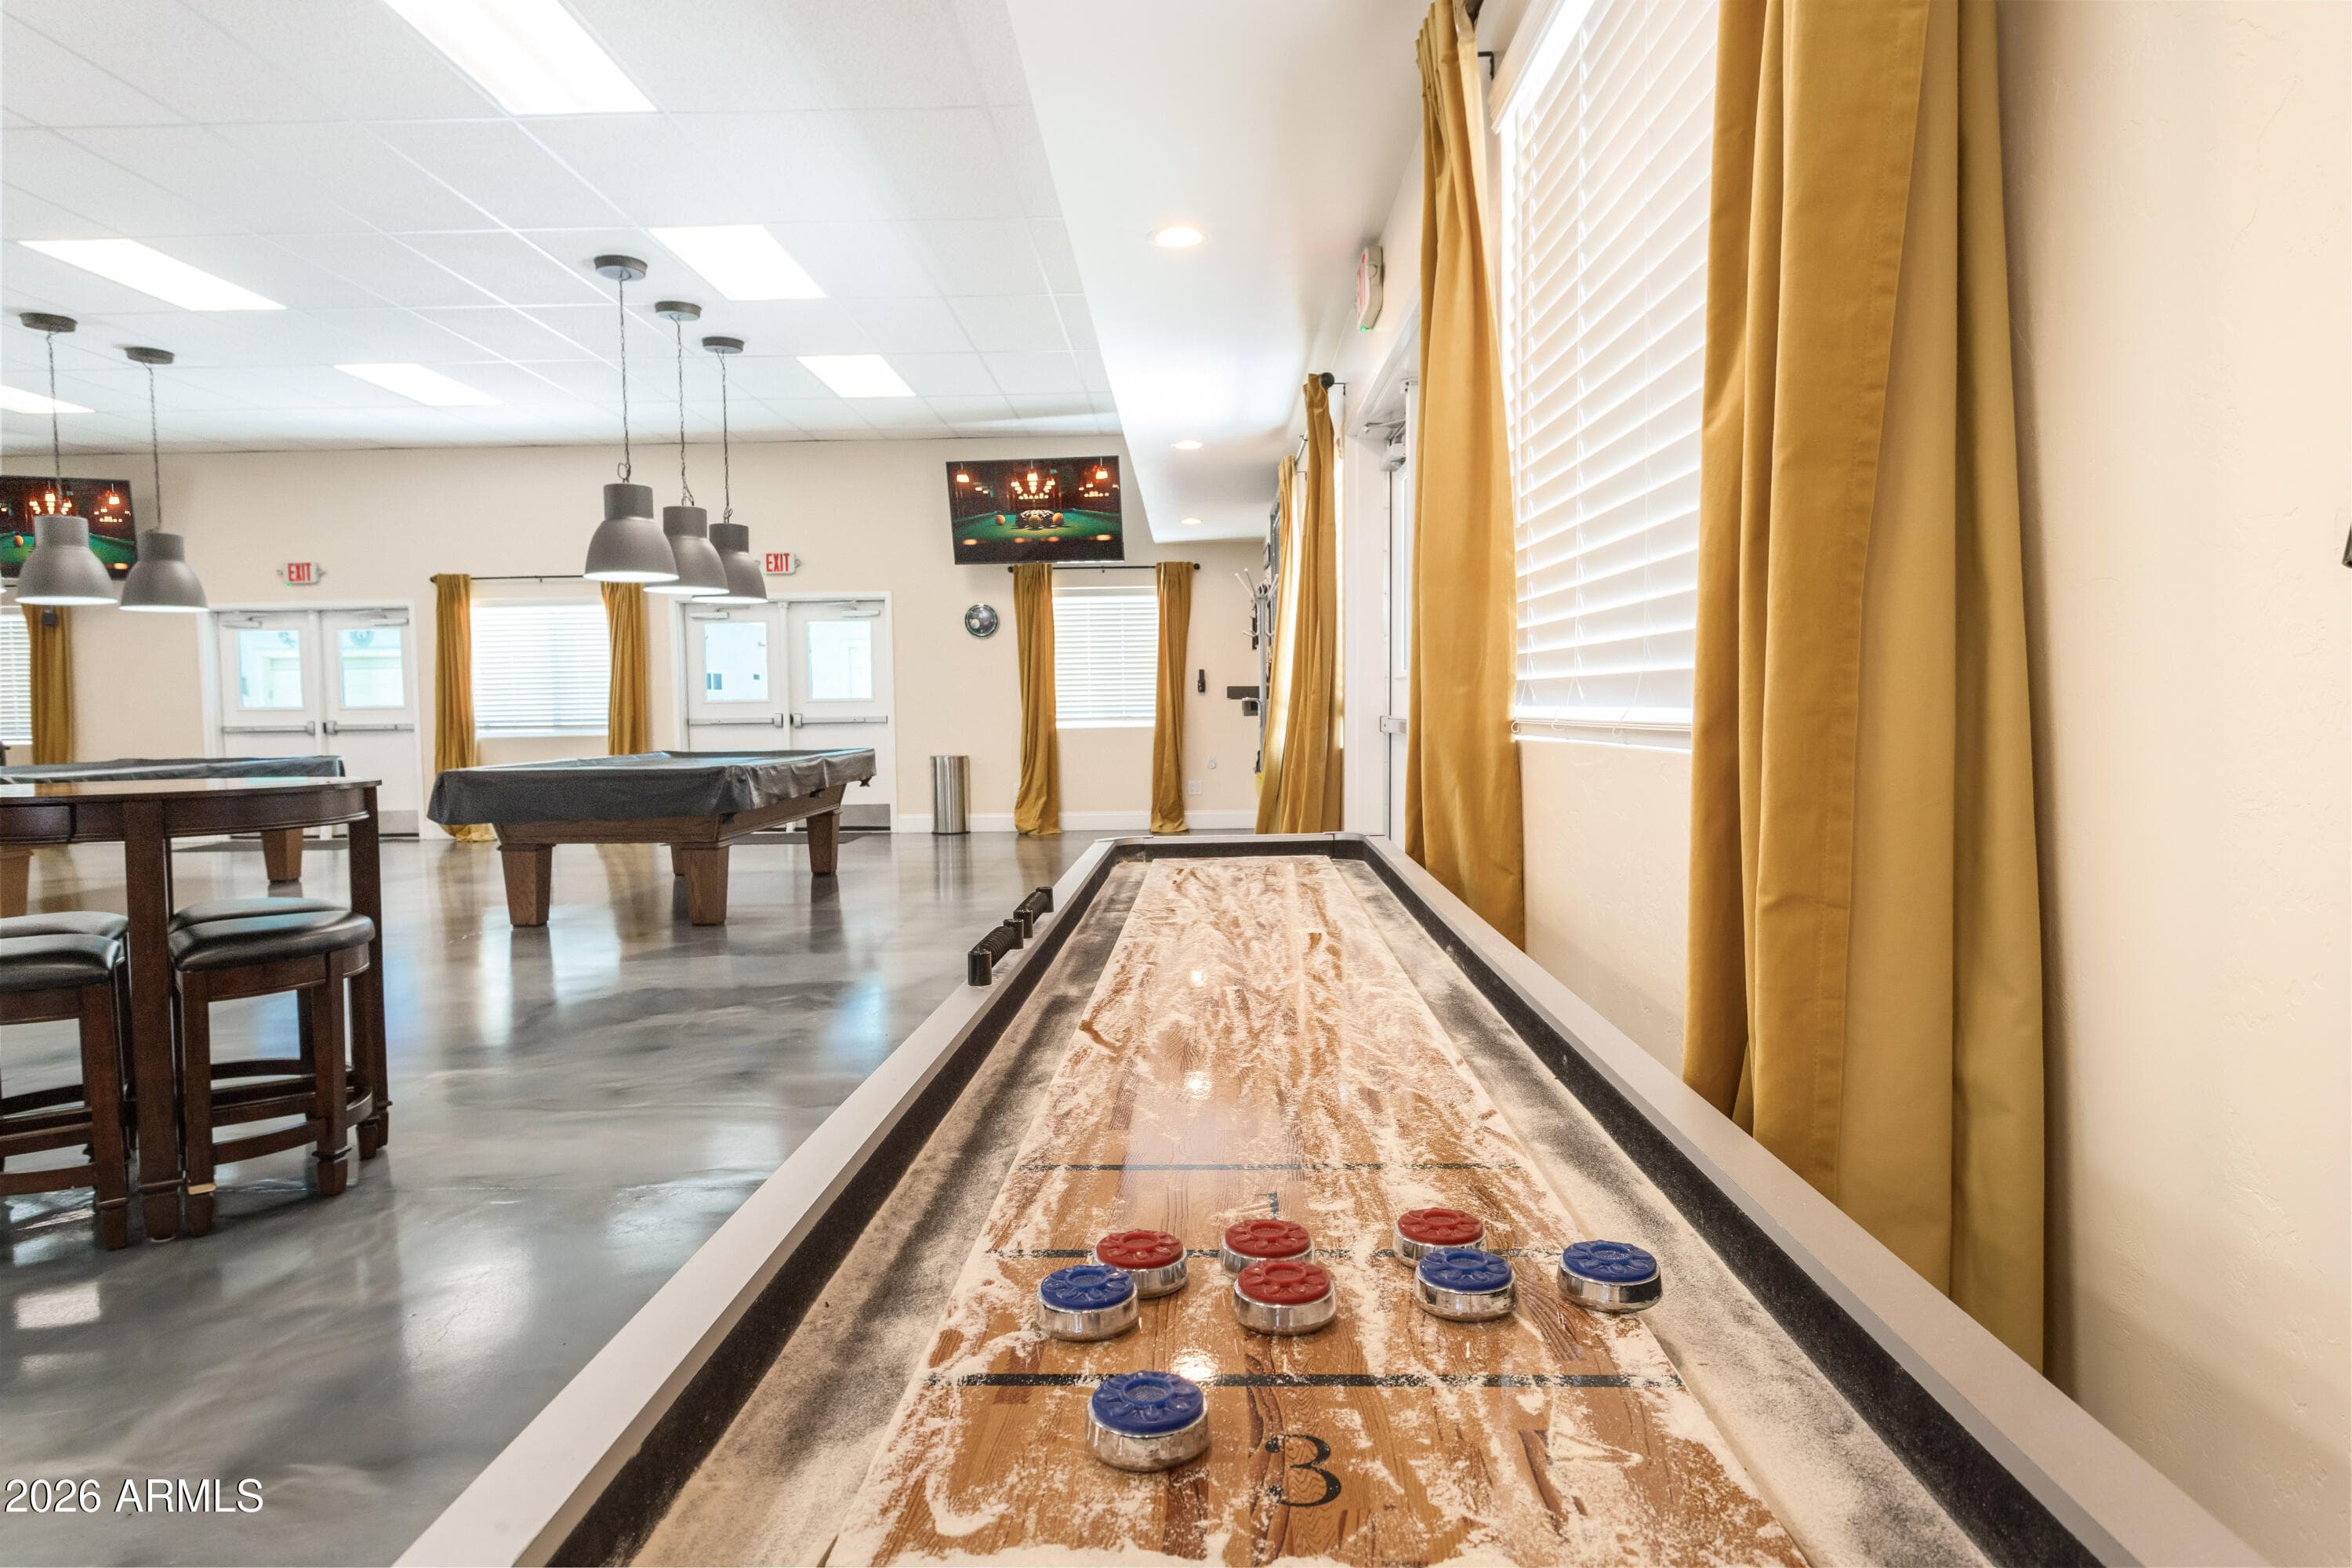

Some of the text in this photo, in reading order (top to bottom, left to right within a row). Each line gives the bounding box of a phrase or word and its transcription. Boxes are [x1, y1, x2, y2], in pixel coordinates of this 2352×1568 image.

[288, 562, 311, 582] EXIT
[766, 553, 789, 572] EXIT
[1265, 1433, 1342, 1508] 3
